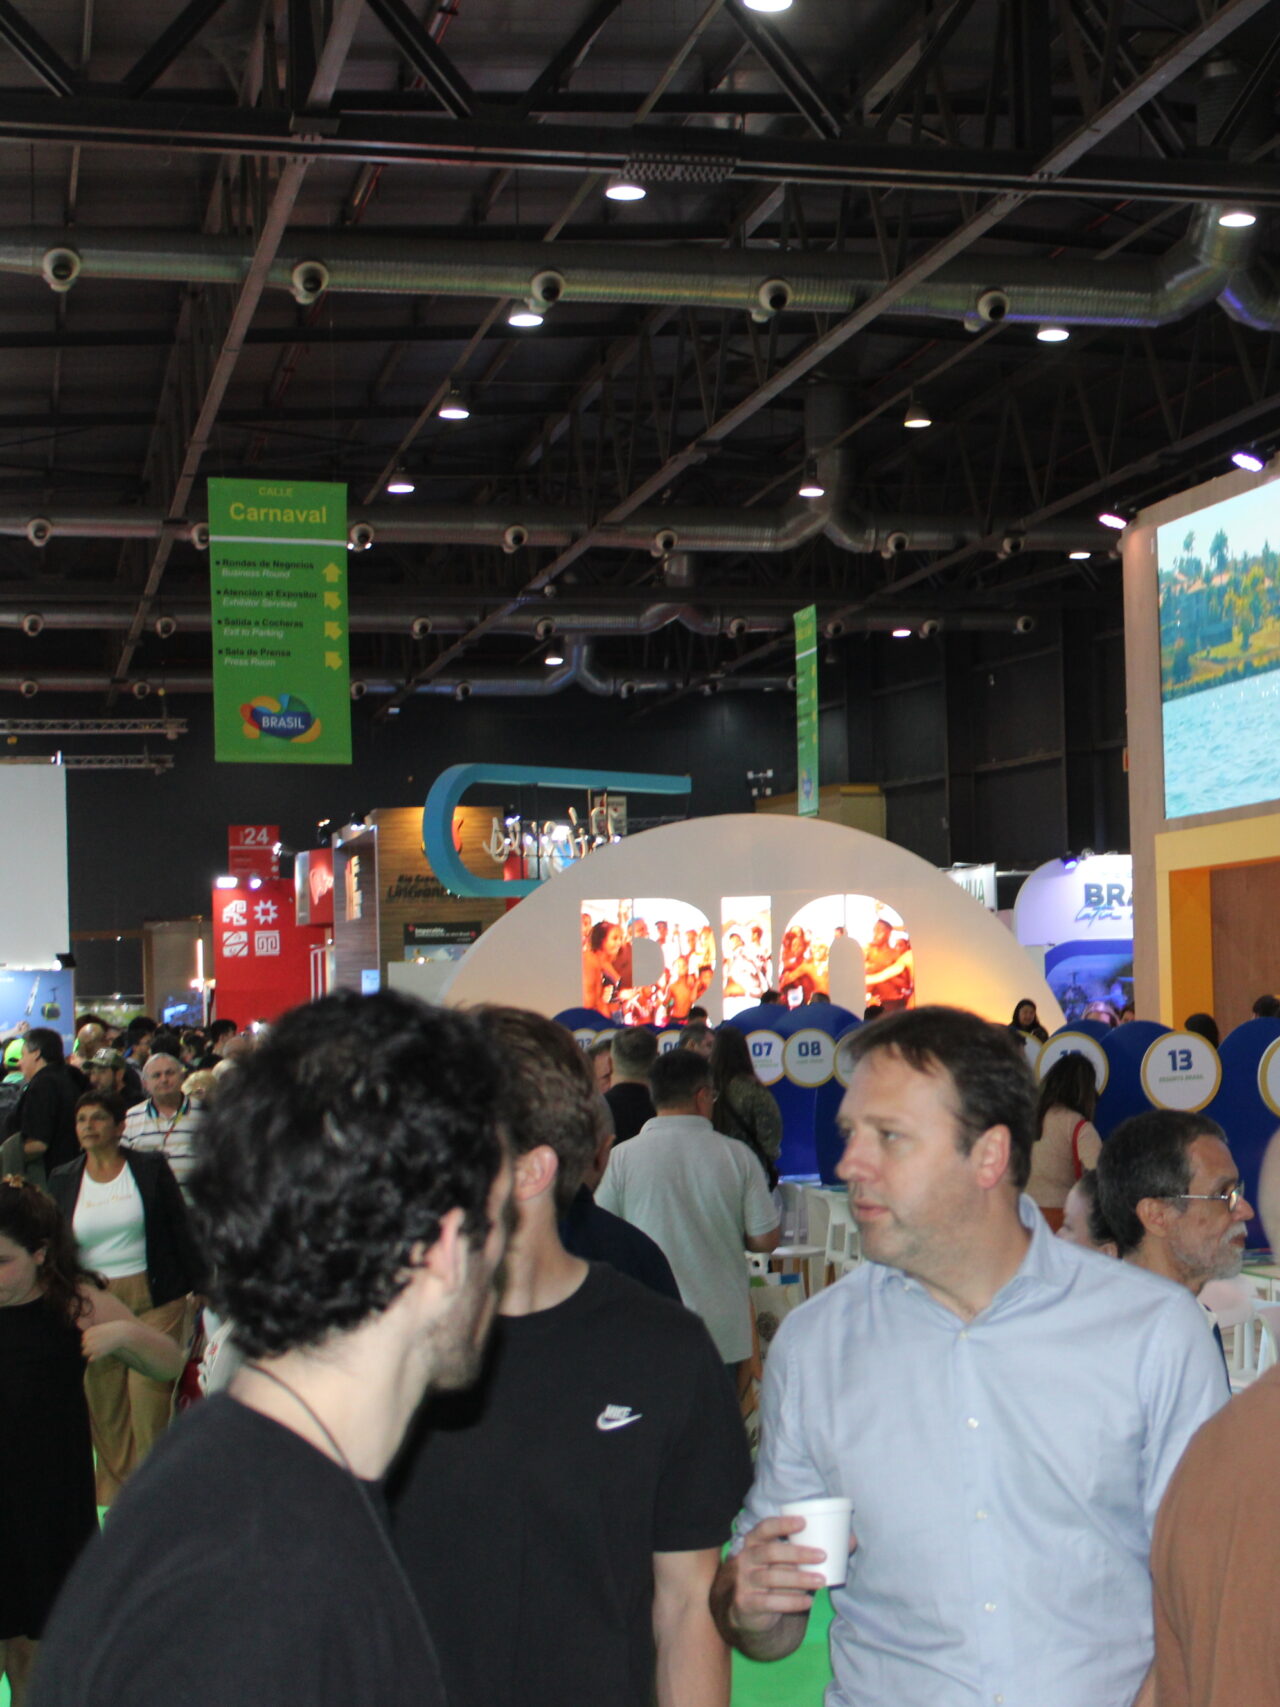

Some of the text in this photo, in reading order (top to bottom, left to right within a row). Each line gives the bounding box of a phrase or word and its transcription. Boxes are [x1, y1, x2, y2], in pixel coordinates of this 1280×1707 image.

[258, 486, 294, 497] CALLE
[229, 502, 328, 523] Carnaval
[261, 715, 305, 730] BRASIL
[243, 827, 270, 845] 24
[1084, 882, 1133, 908] BR
[752, 1042, 773, 1057] 07
[798, 1041, 821, 1057] 08
[1168, 1048, 1193, 1072] 13
